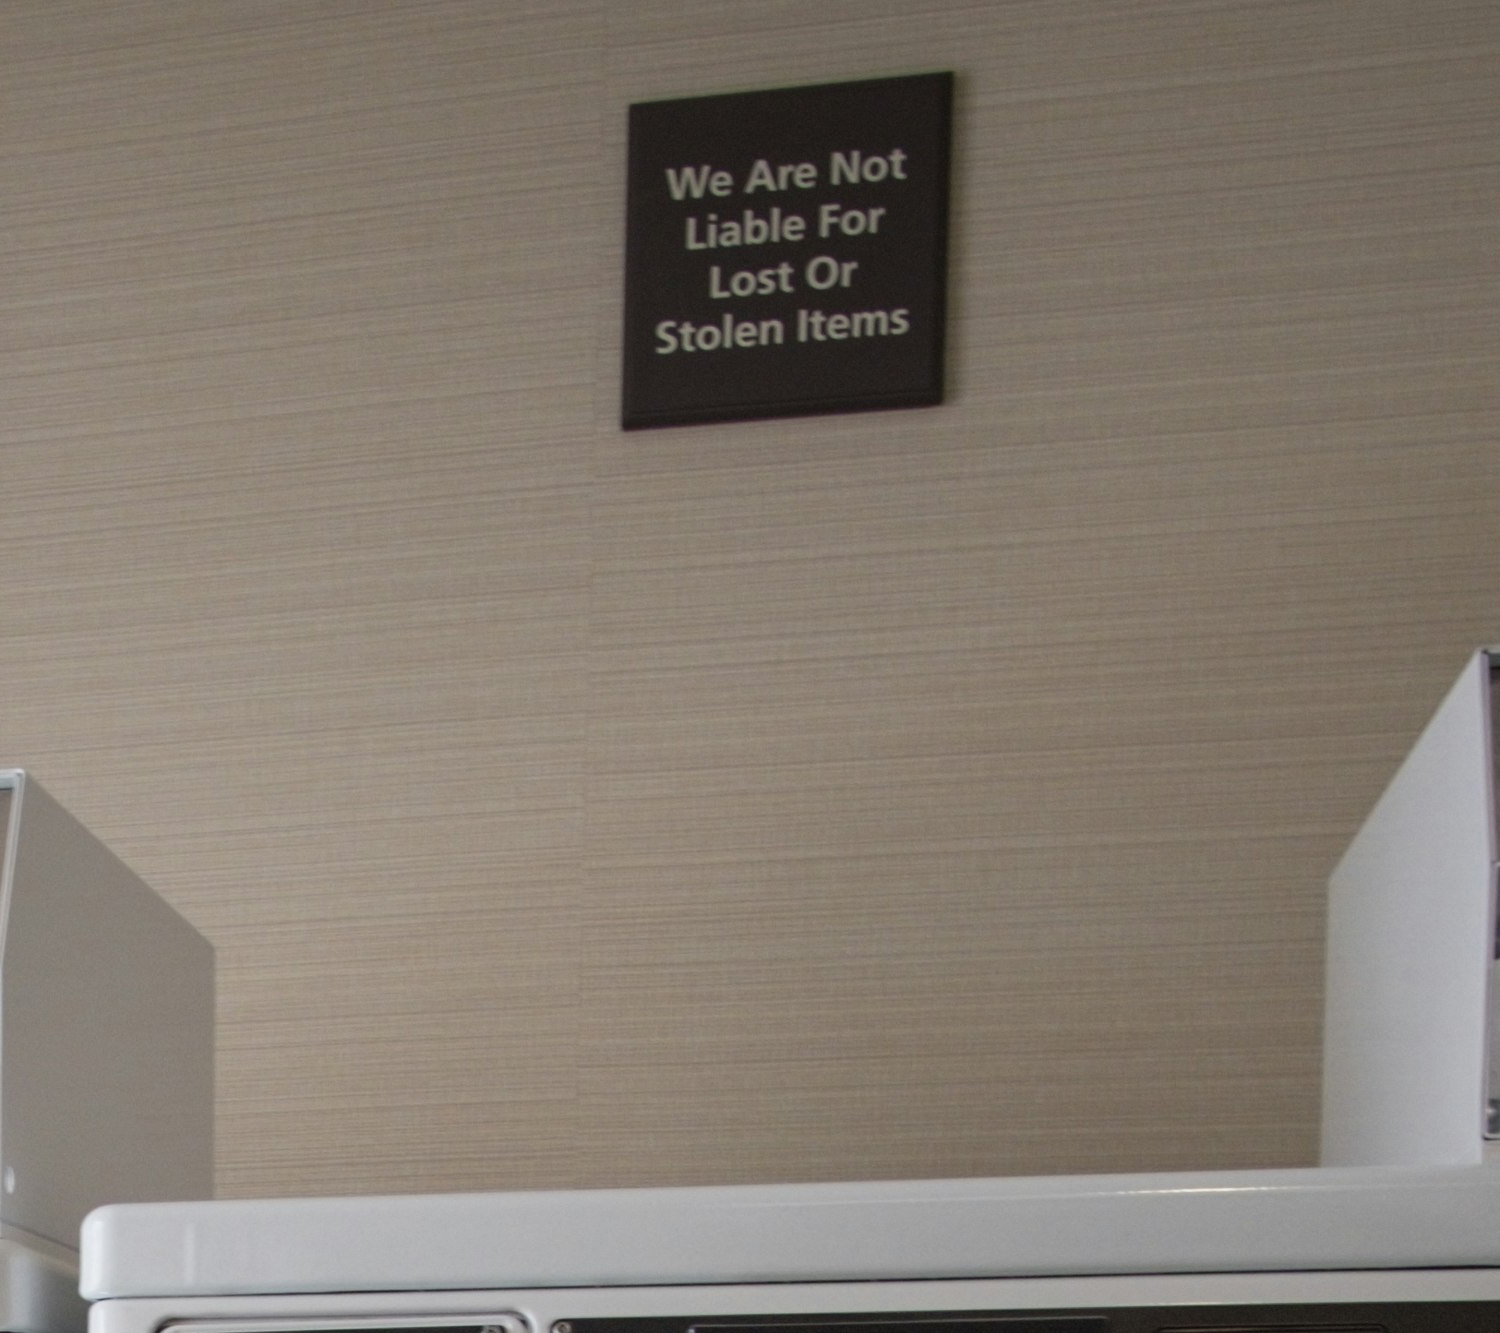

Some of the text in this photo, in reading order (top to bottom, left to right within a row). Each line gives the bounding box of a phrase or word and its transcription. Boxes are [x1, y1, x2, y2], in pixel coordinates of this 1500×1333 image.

[665, 149, 908, 201] We Are Not
[685, 204, 886, 250] Liable For
[709, 256, 859, 299] Lost Or
[654, 307, 911, 355] Stolen Items
